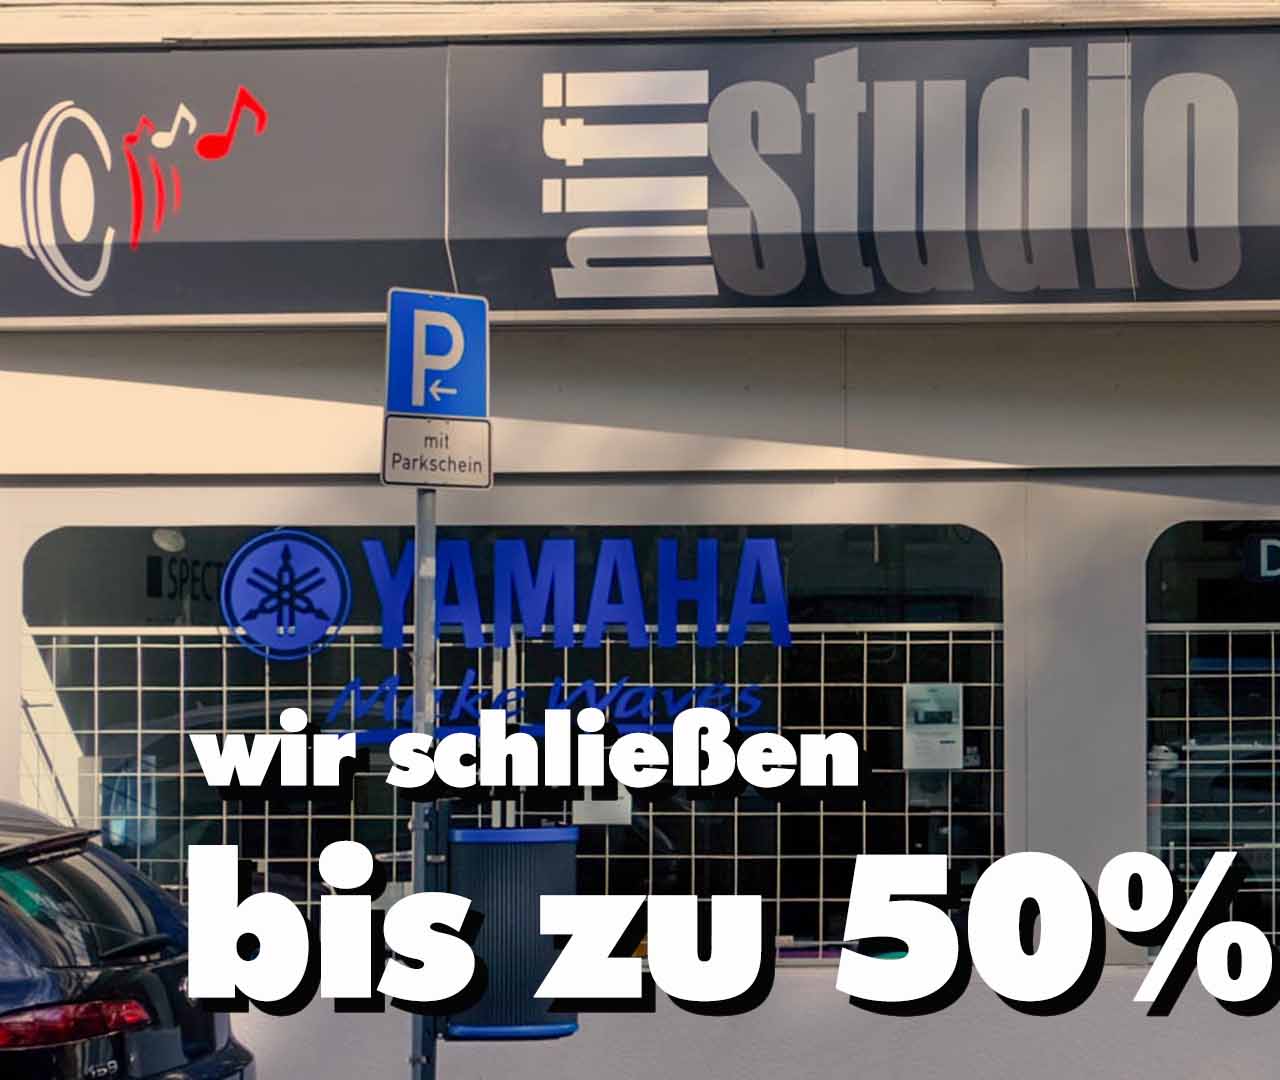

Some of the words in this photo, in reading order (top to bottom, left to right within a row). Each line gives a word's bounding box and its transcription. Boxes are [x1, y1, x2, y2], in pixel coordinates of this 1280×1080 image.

[542, 69, 719, 299] hifi
[708, 42, 1242, 295] studio
[412, 309, 464, 406] P
[391, 453, 483, 474] Parkschein
[424, 432, 449, 449] mit
[362, 538, 792, 649] YAMAHA
[549, 674, 766, 721] Waves
